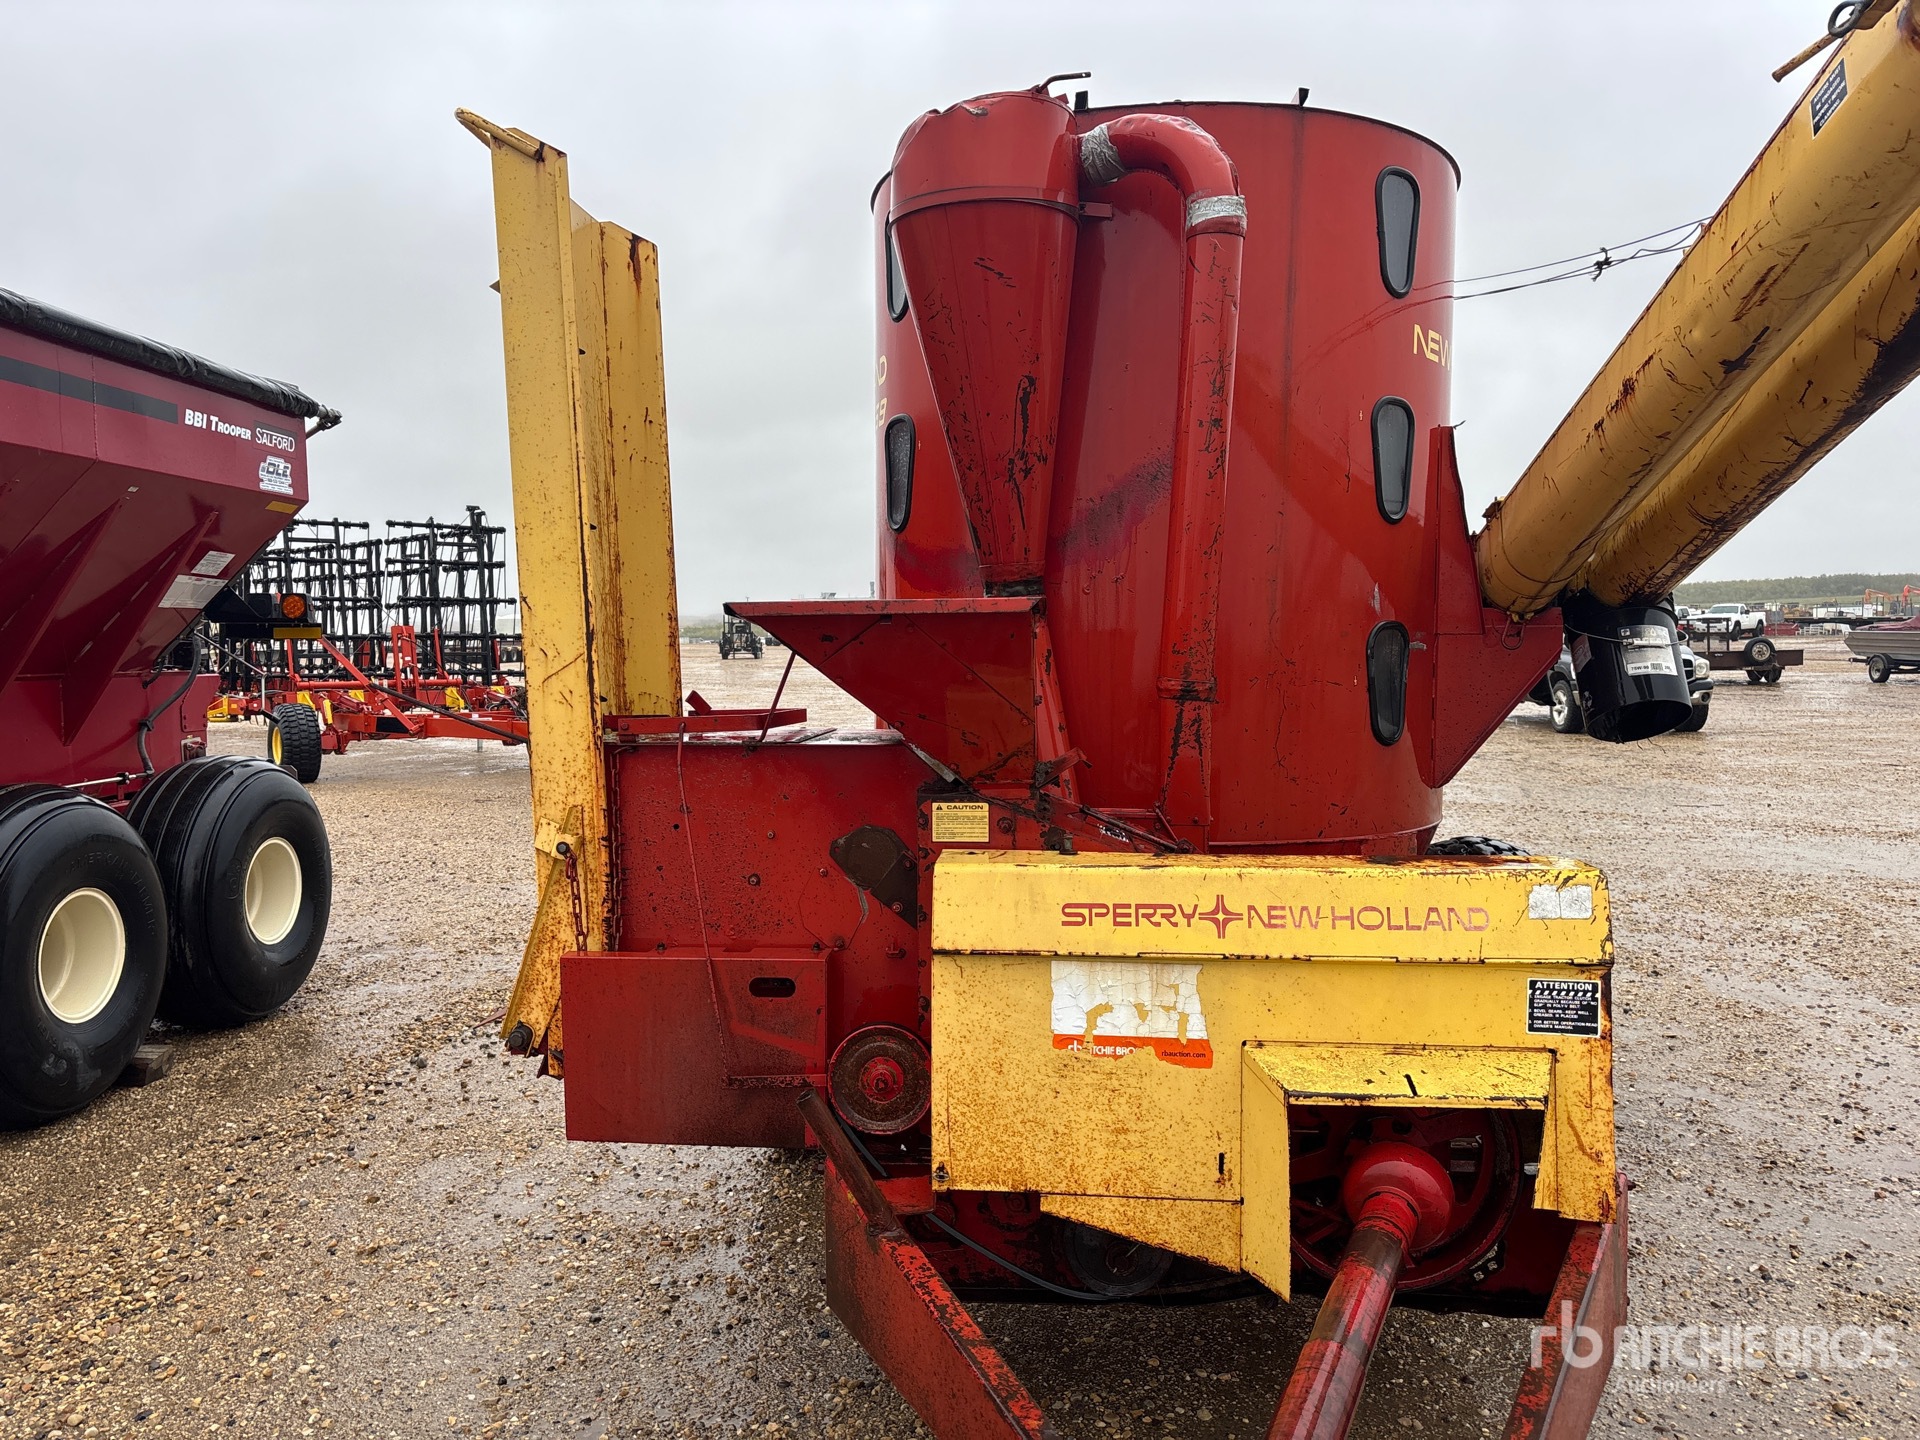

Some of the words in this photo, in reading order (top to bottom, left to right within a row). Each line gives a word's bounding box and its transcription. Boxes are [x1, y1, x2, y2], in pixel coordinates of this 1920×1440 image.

[1413, 324, 1452, 371] NEW
[184, 408, 207, 429] BBI
[210, 415, 252, 440] TROOPER
[255, 427, 295, 452] SALFORD
[1061, 903, 1199, 927] SPERRY
[1247, 905, 1321, 929] NEW
[1330, 906, 1489, 932] HOLLAND
[1535, 981, 1593, 990] ATTENTION
[1162, 1050, 1206, 1058] rbauction.com
